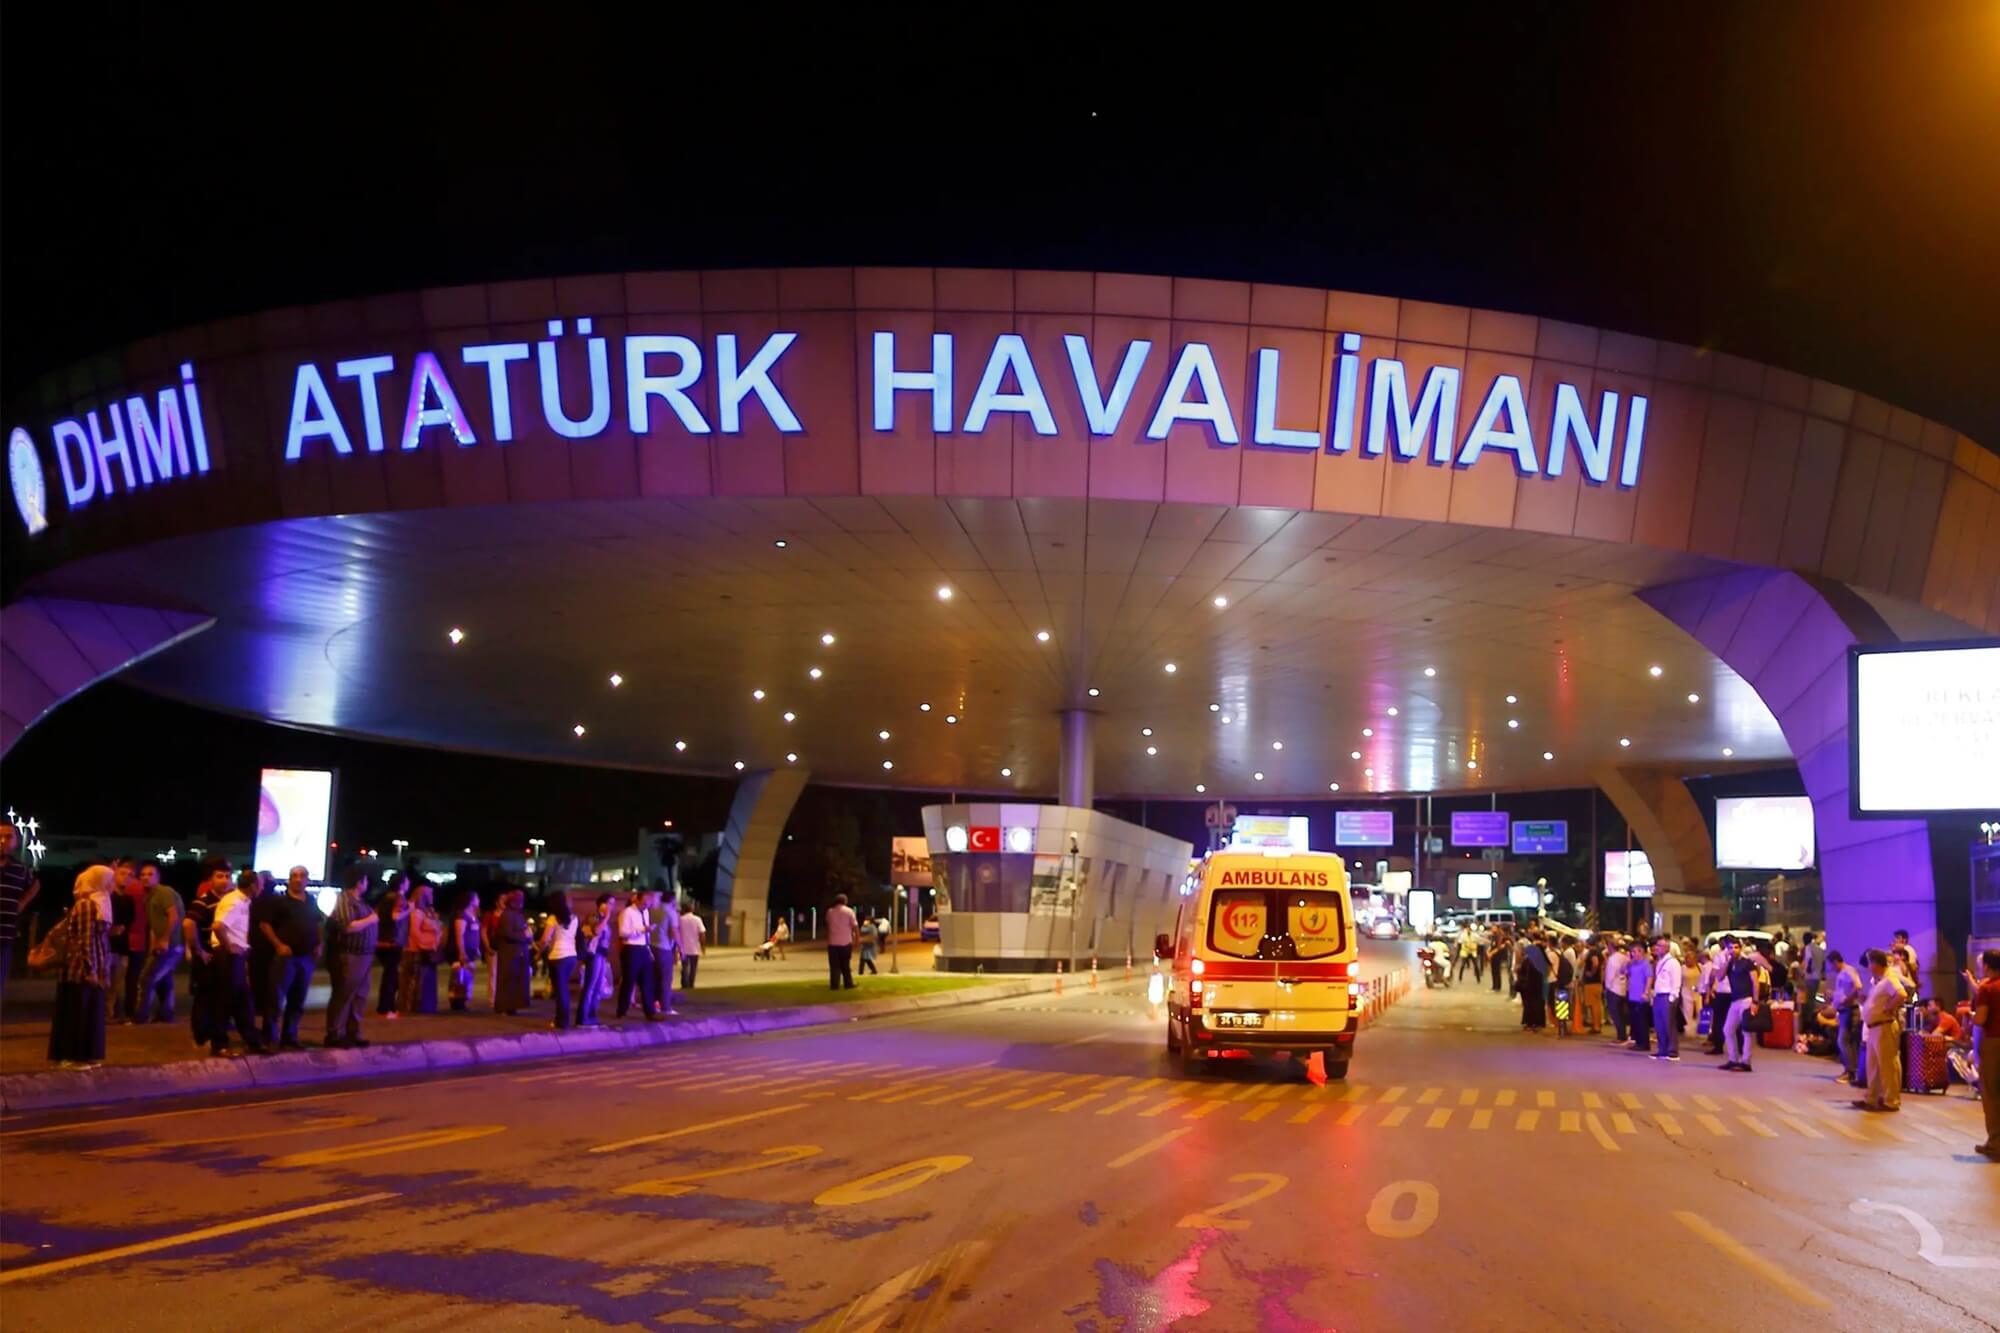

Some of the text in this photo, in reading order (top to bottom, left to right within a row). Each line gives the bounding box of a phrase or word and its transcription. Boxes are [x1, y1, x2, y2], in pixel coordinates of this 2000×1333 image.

[52, 317, 1649, 506] DHMİ ATATÜRK HAVALİMANI
[1221, 871, 1328, 887] AMBULANS
[1232, 913, 1258, 928] 112
[1176, 1172, 1440, 1238] 20
